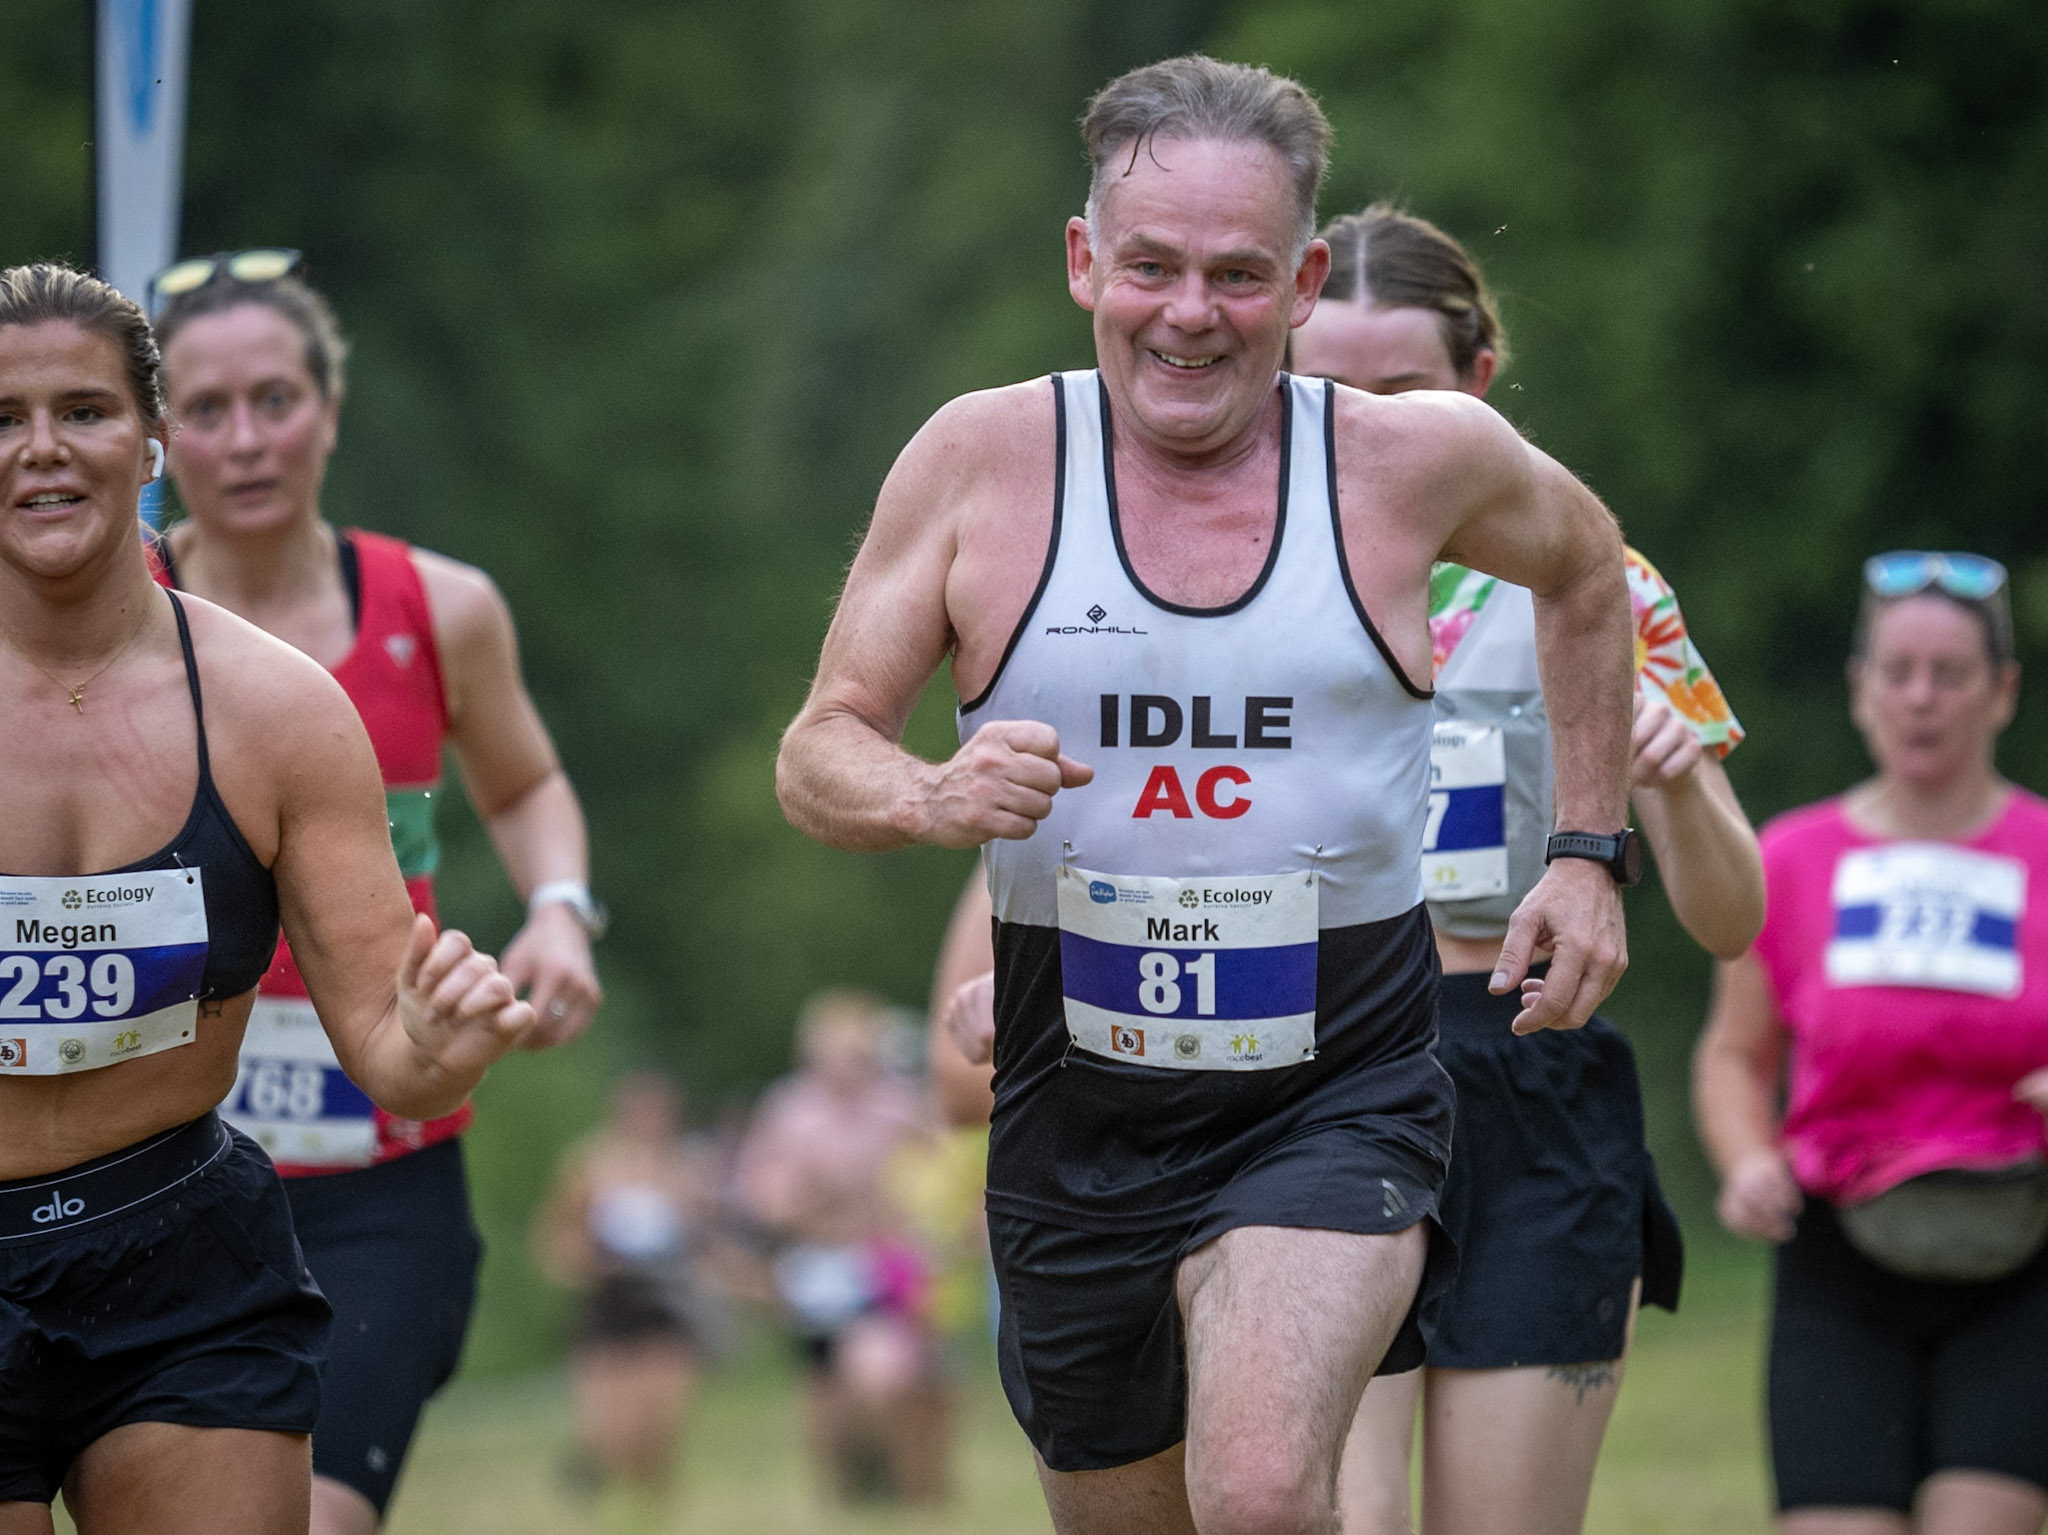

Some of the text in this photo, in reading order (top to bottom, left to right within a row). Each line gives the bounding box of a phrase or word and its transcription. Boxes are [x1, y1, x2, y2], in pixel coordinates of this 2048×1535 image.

[1046, 626, 1148, 635] RONHILL
[1100, 694, 1293, 749] IDLE
[1132, 765, 1252, 820] AC
[86, 886, 155, 904] Ecology
[1203, 888, 1273, 905] Ecology
[16, 919, 117, 949] Megan
[1147, 918, 1220, 941] Mark
[0, 953, 135, 1019] 239
[1138, 951, 1216, 1015] 81
[1226, 1053, 1263, 1063] racebest
[32, 1191, 85, 1224] alo
